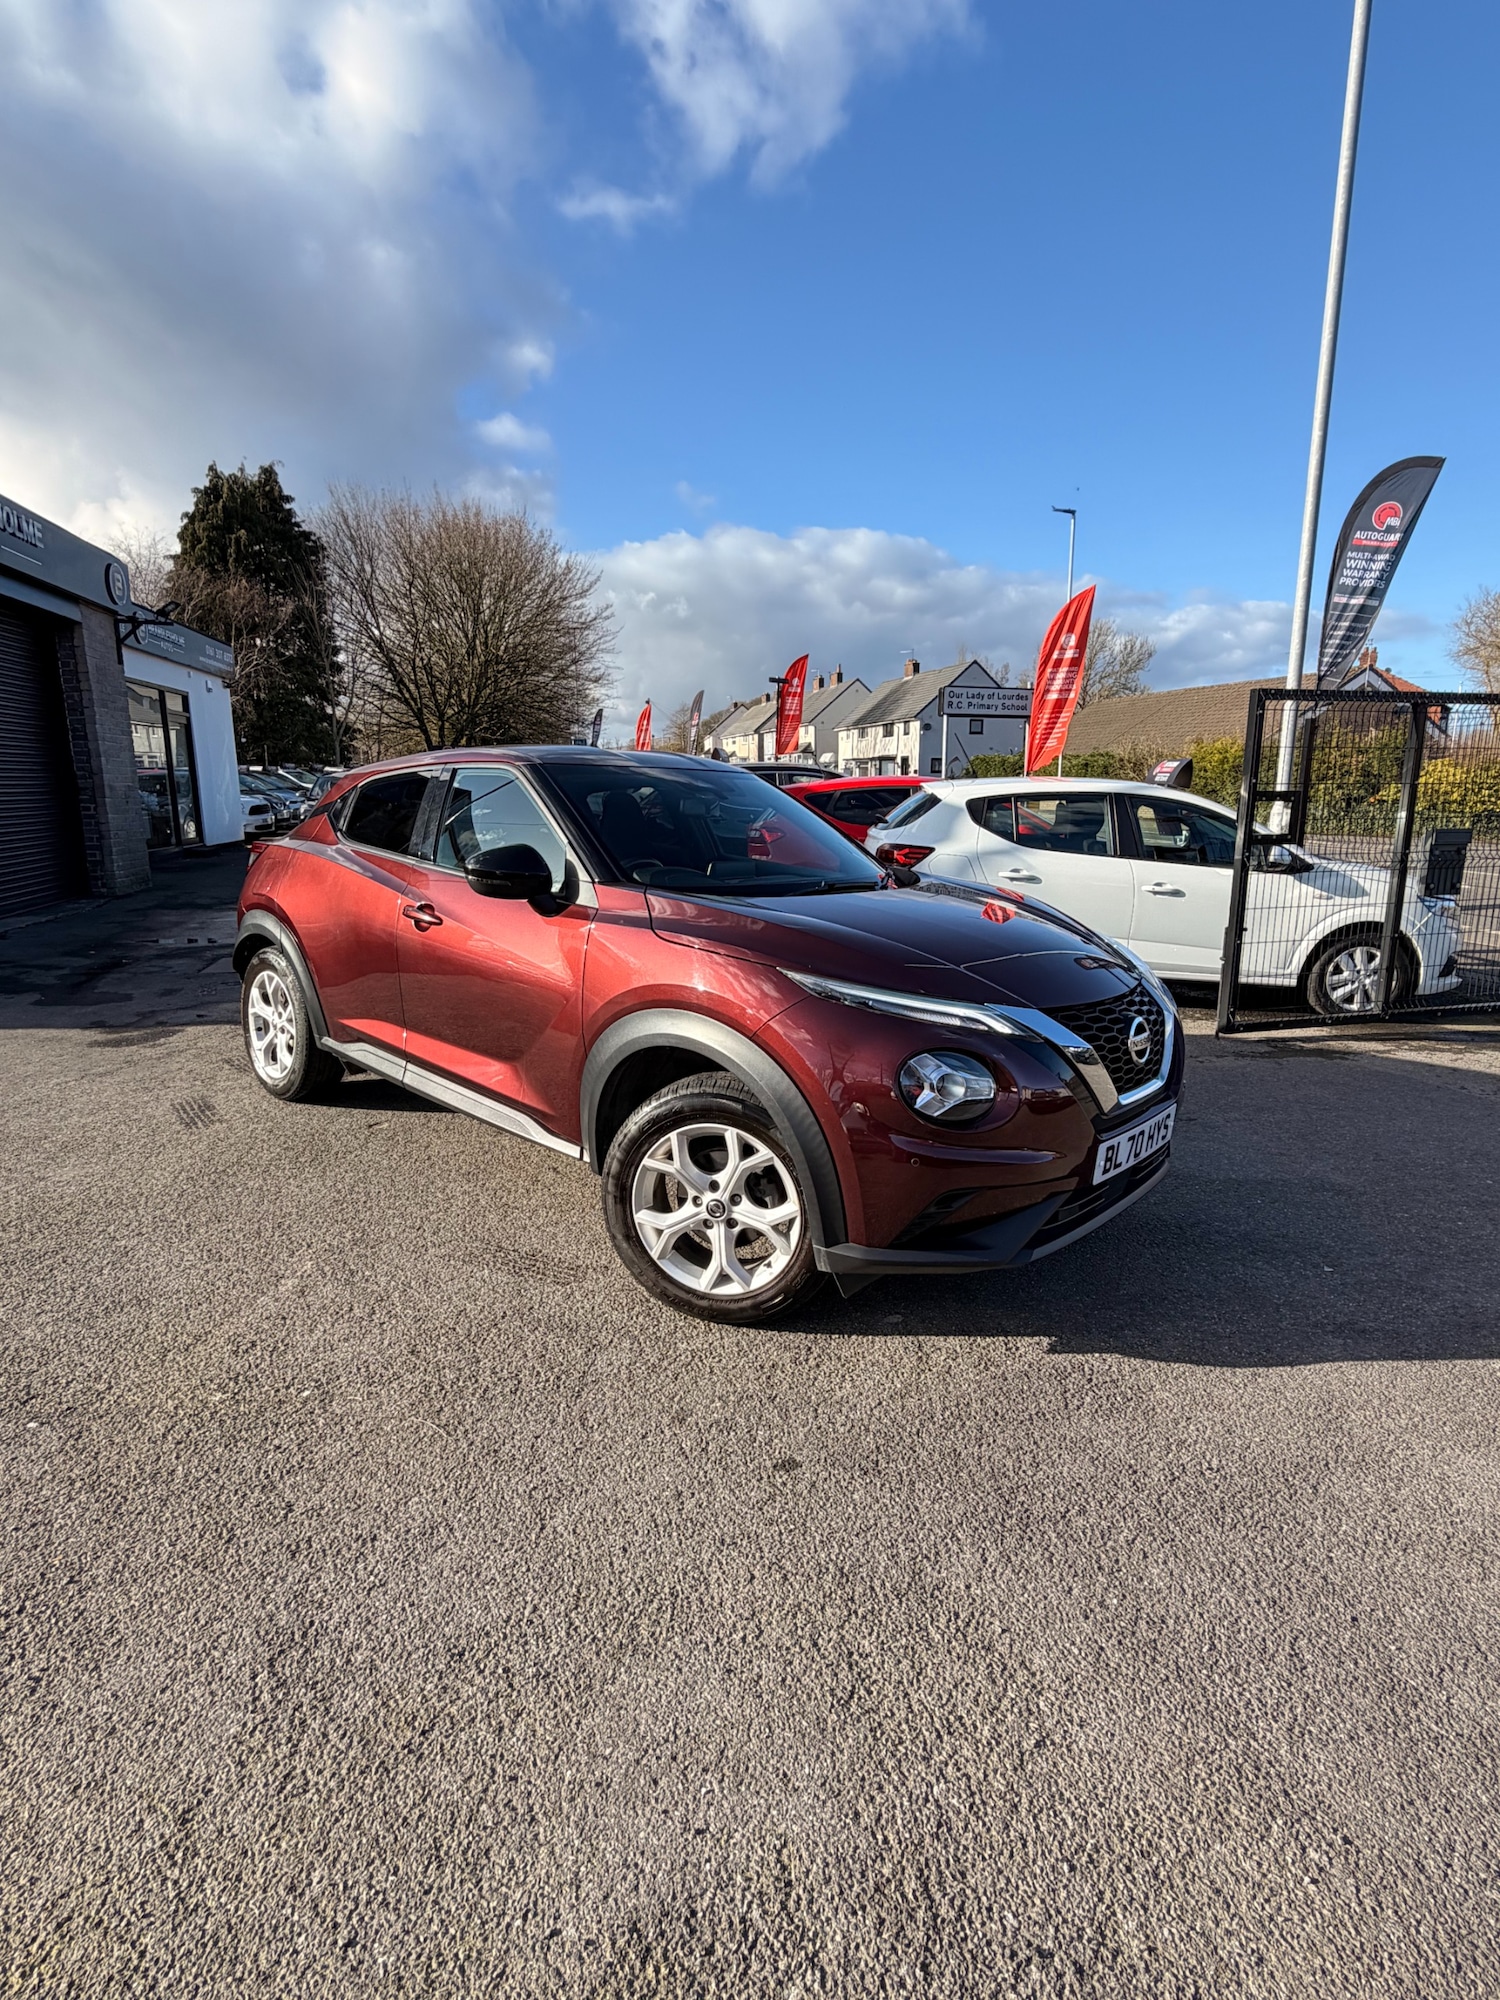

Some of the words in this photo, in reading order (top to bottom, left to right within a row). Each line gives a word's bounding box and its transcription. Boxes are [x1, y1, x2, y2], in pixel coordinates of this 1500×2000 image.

[1346, 551, 1396, 561] MULTI-AWAD
[1346, 558, 1392, 571] WINNING
[948, 690, 964, 699] Our
[966, 691, 985, 701] Lady
[987, 691, 995, 700] of
[997, 692, 1029, 701] Lourdes
[947, 700, 966, 709] R.C.
[967, 701, 999, 711] Primary
[1001, 702, 1028, 711] School
[1144, 1113, 1171, 1153] HYS
